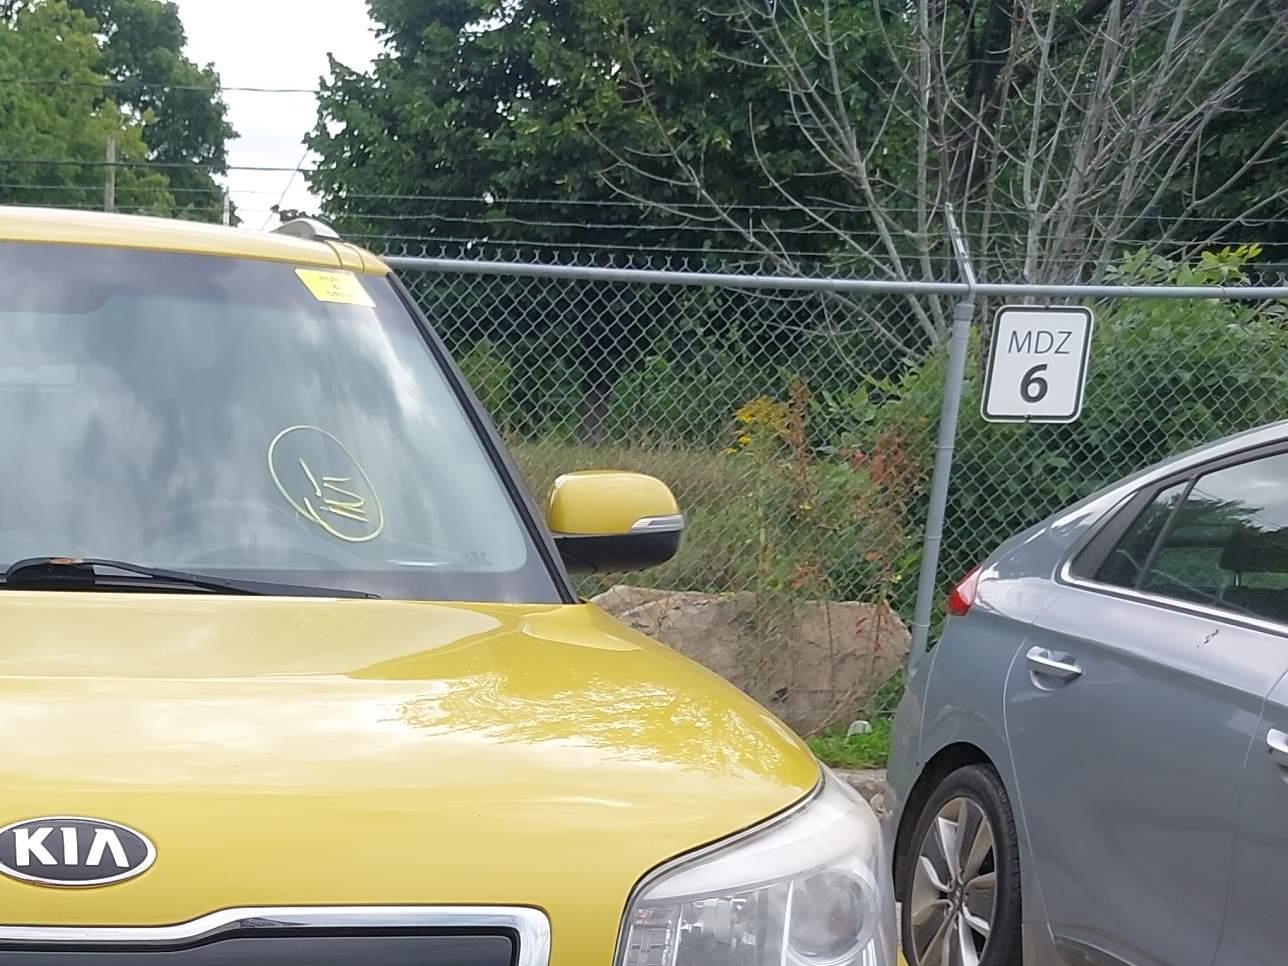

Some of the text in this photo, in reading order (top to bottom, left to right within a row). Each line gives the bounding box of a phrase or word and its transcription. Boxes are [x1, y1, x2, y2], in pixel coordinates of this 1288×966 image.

[1007, 330, 1073, 355] MDZ
[1020, 363, 1048, 403] 6
[13, 827, 130, 868] KIA
